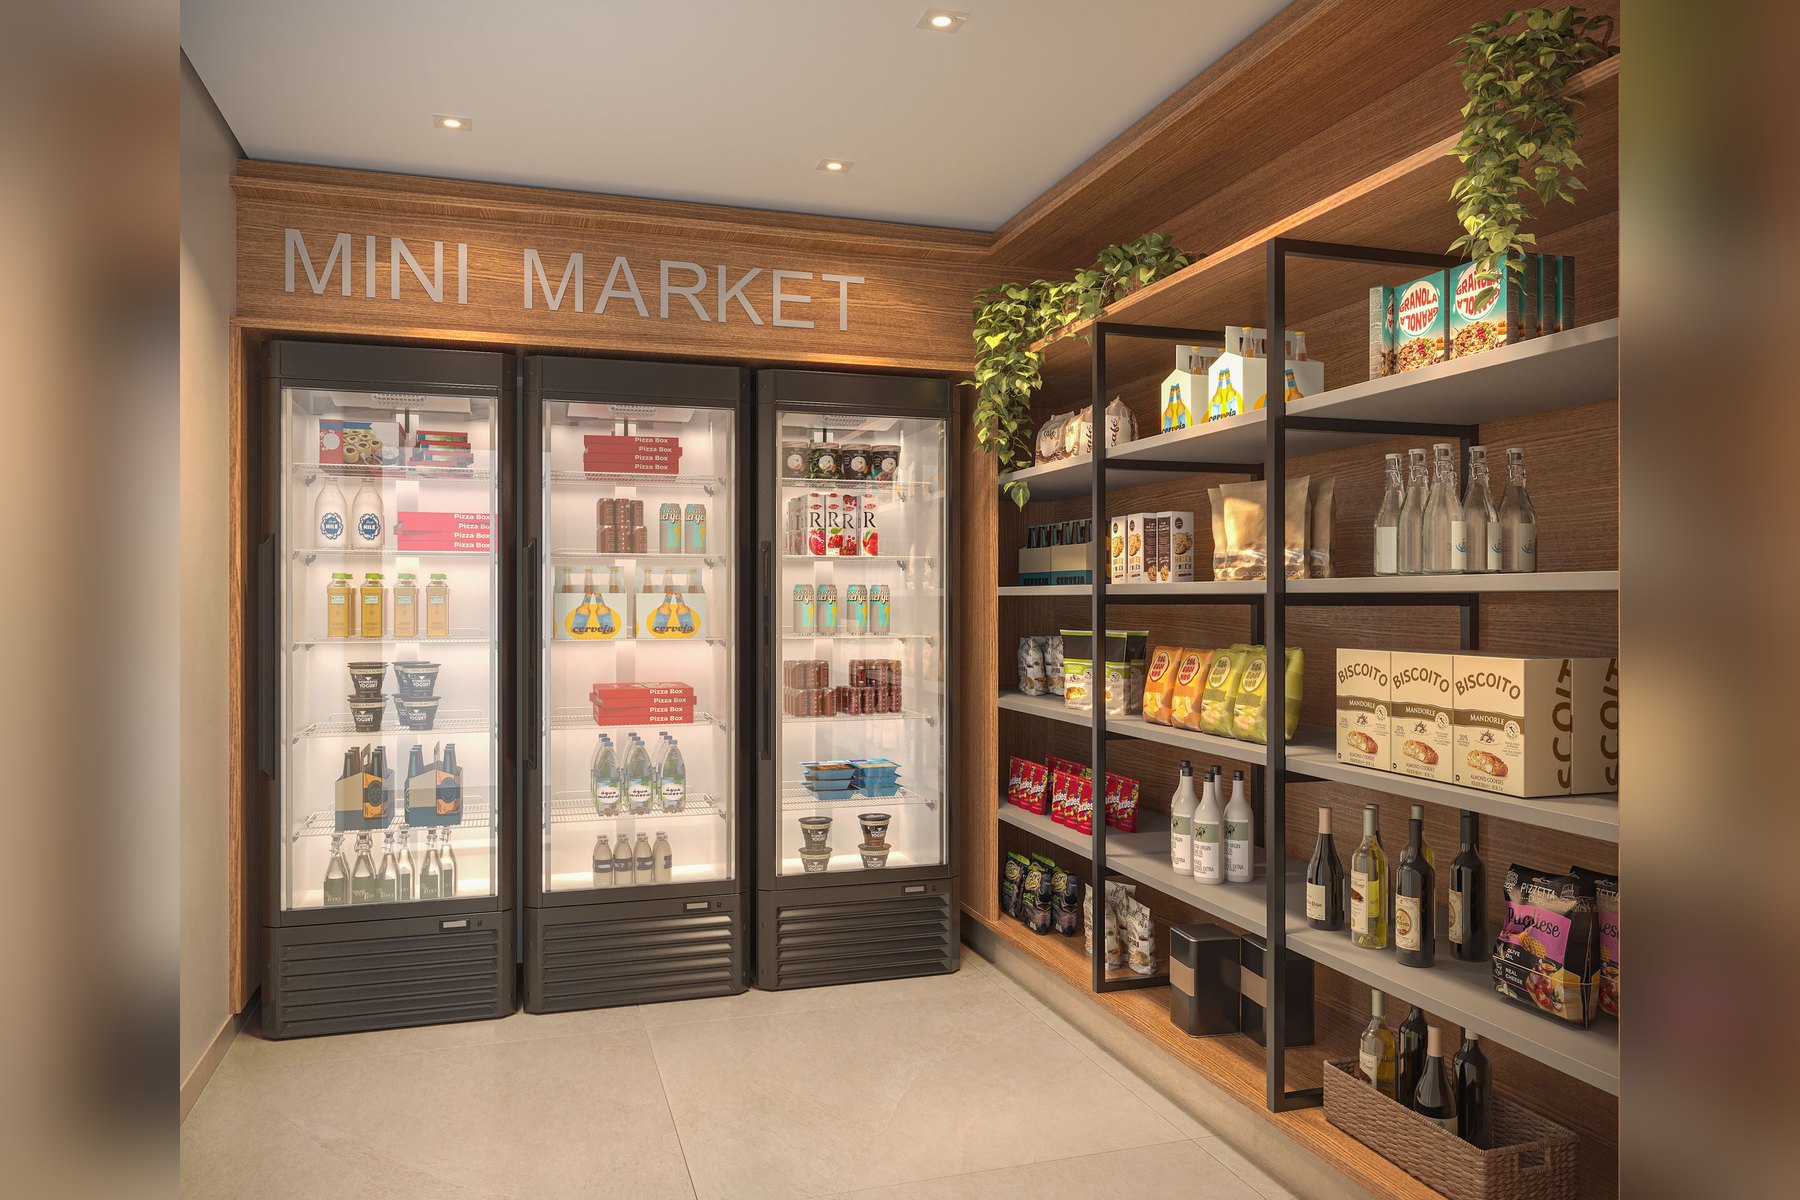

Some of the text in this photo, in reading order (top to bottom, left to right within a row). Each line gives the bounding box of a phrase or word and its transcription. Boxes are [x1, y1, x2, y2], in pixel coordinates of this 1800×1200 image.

[285, 228, 865, 331] MINI MARKET
[1400, 288, 1437, 313] GRANOLA
[1400, 307, 1438, 331] GRANOLA
[810, 512, 823, 527] R
[828, 512, 840, 527] R
[864, 512, 876, 528] R
[573, 624, 614, 634] cerveja
[653, 624, 693, 634] cerveja
[1338, 663, 1387, 687] BISCOITO
[1393, 667, 1449, 692] BISCOITO
[1455, 672, 1521, 699] BISCOITO
[1349, 700, 1375, 709] MANDORLE
[1405, 706, 1435, 717] MANDORLE
[1470, 714, 1504, 725] MANDORLE
[1470, 774, 1504, 785] ALMOND COOKIES
[1520, 882, 1555, 900] PIZZETTA
[1508, 907, 1560, 938] Pugliese
[1507, 947, 1520, 957] OLIVE
[1505, 967, 1518, 976] REAL
[1505, 974, 1523, 985] CHEESE
